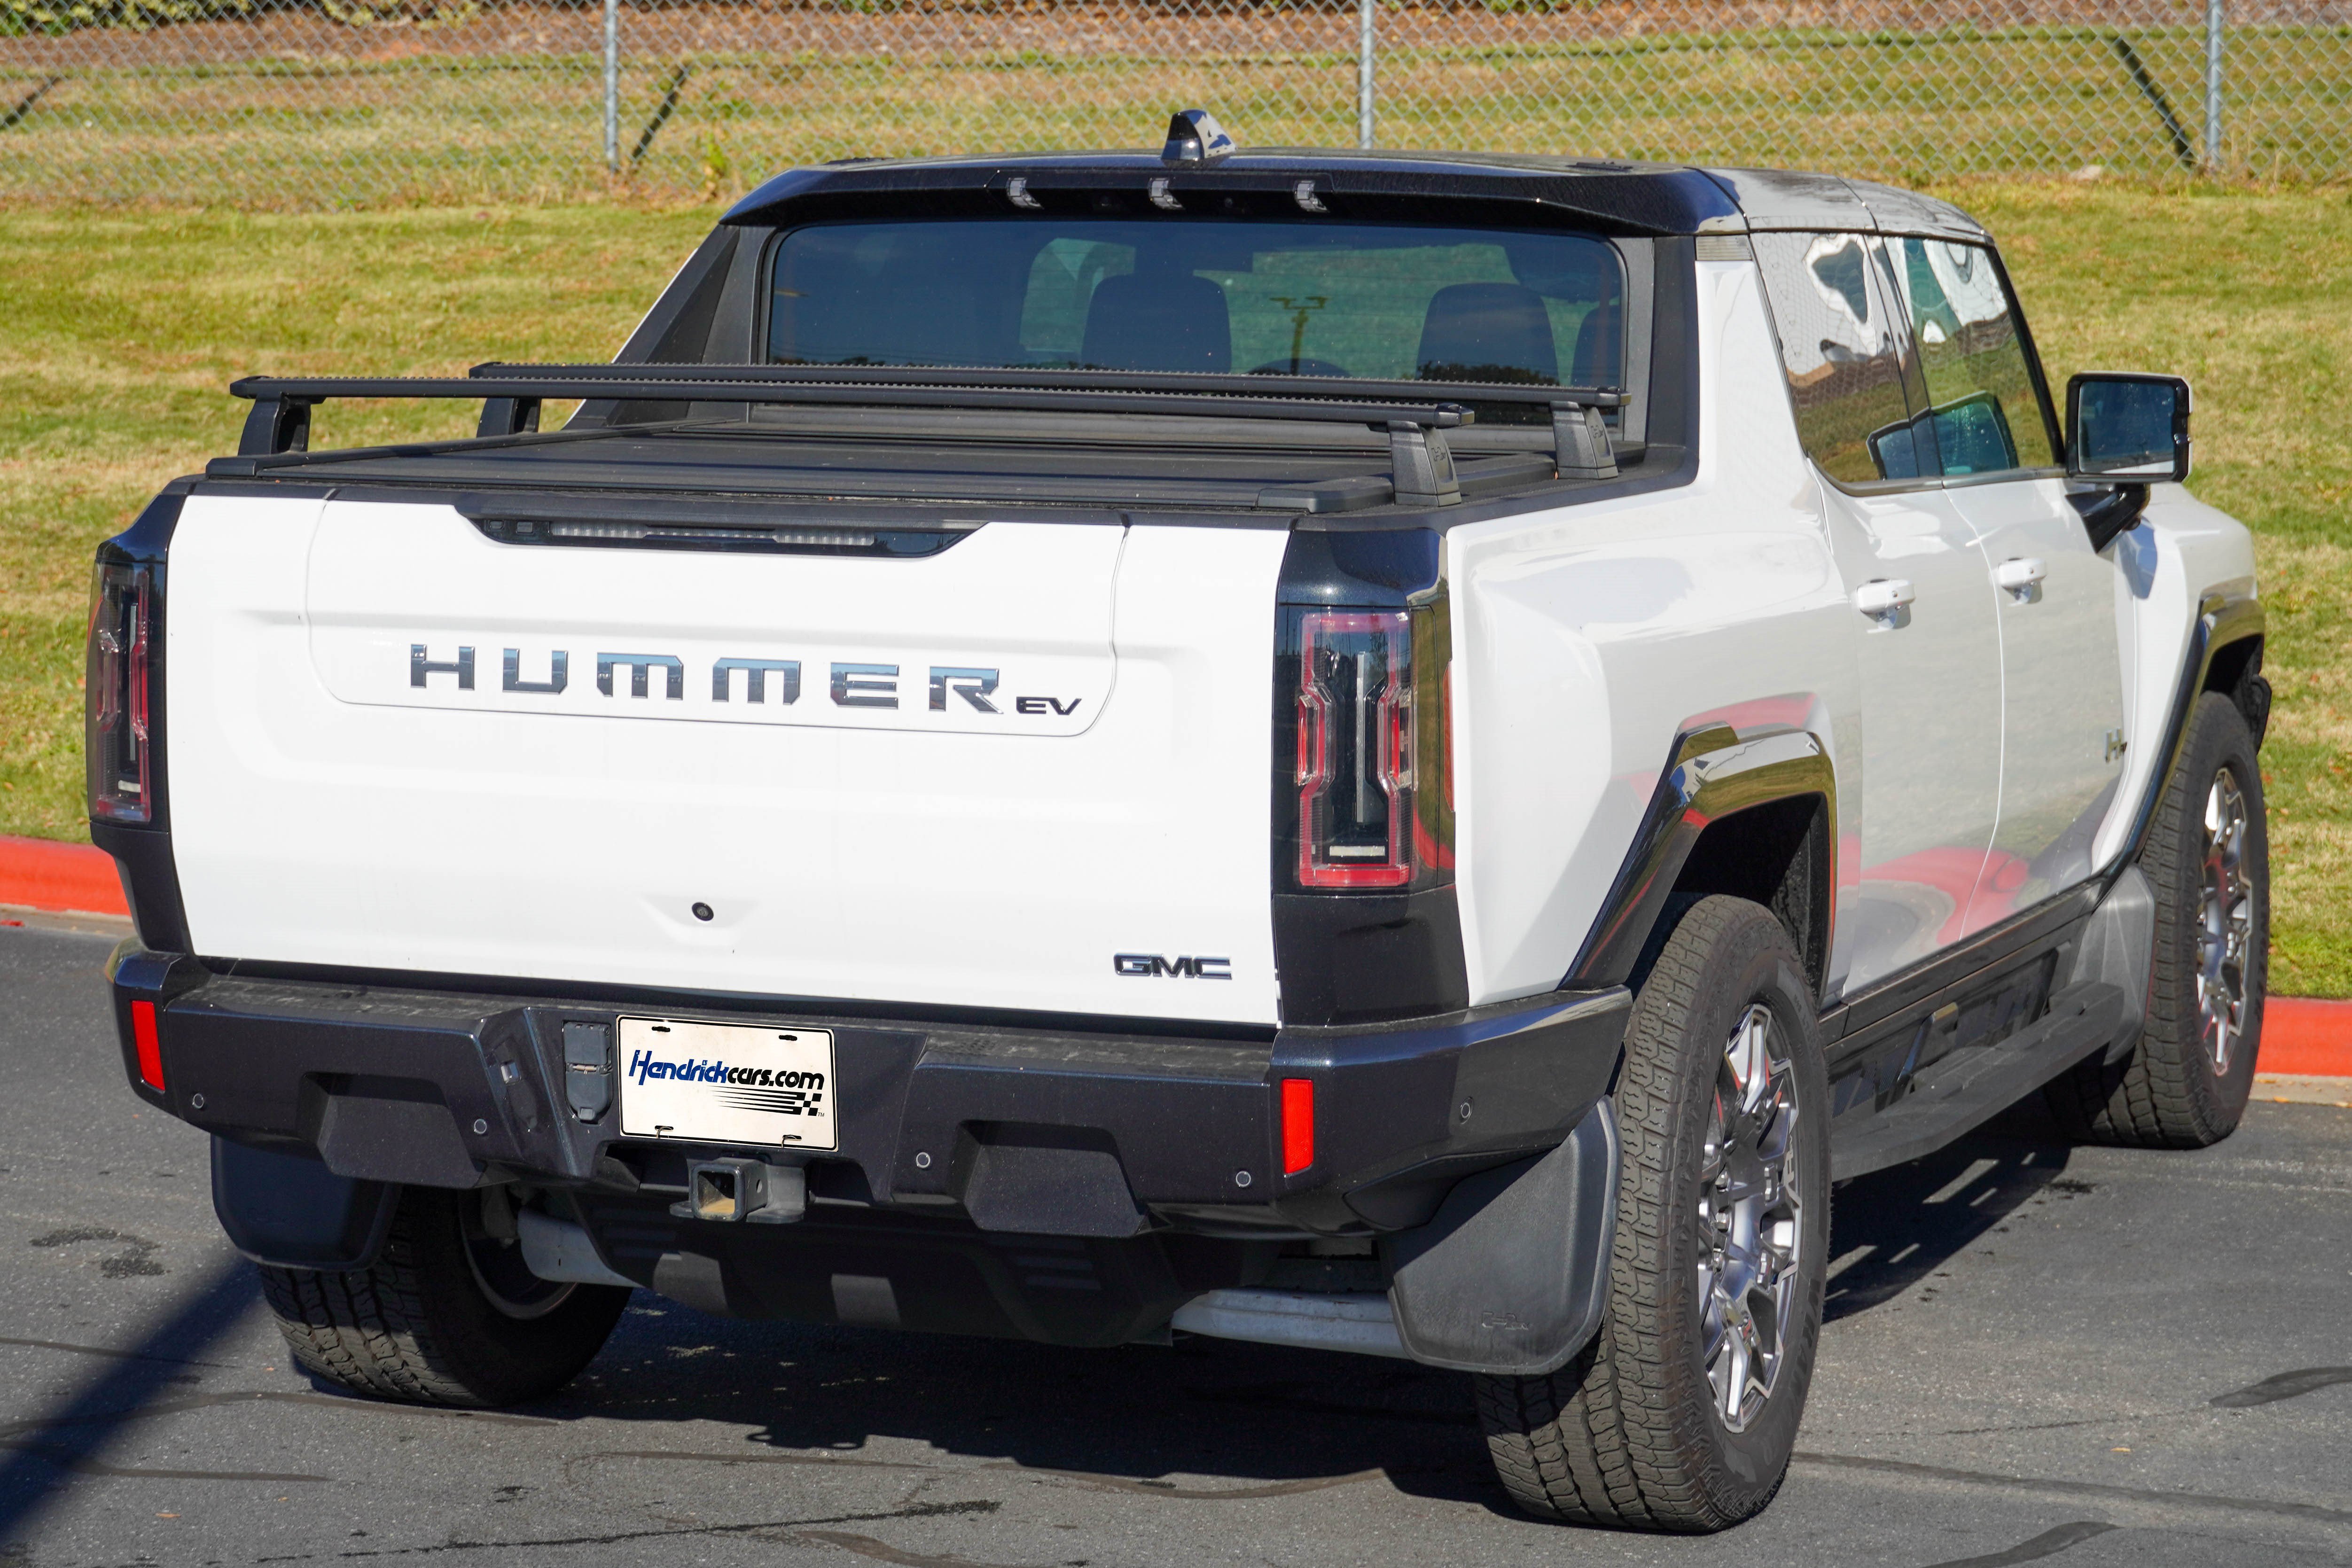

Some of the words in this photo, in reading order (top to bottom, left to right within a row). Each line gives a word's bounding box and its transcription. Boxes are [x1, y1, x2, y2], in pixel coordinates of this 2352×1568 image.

[409, 644, 1004, 714] HUMMER
[1016, 696, 1082, 715] EV
[1113, 952, 1232, 980] GMC
[628, 1049, 825, 1090] Hendrickcars.com
